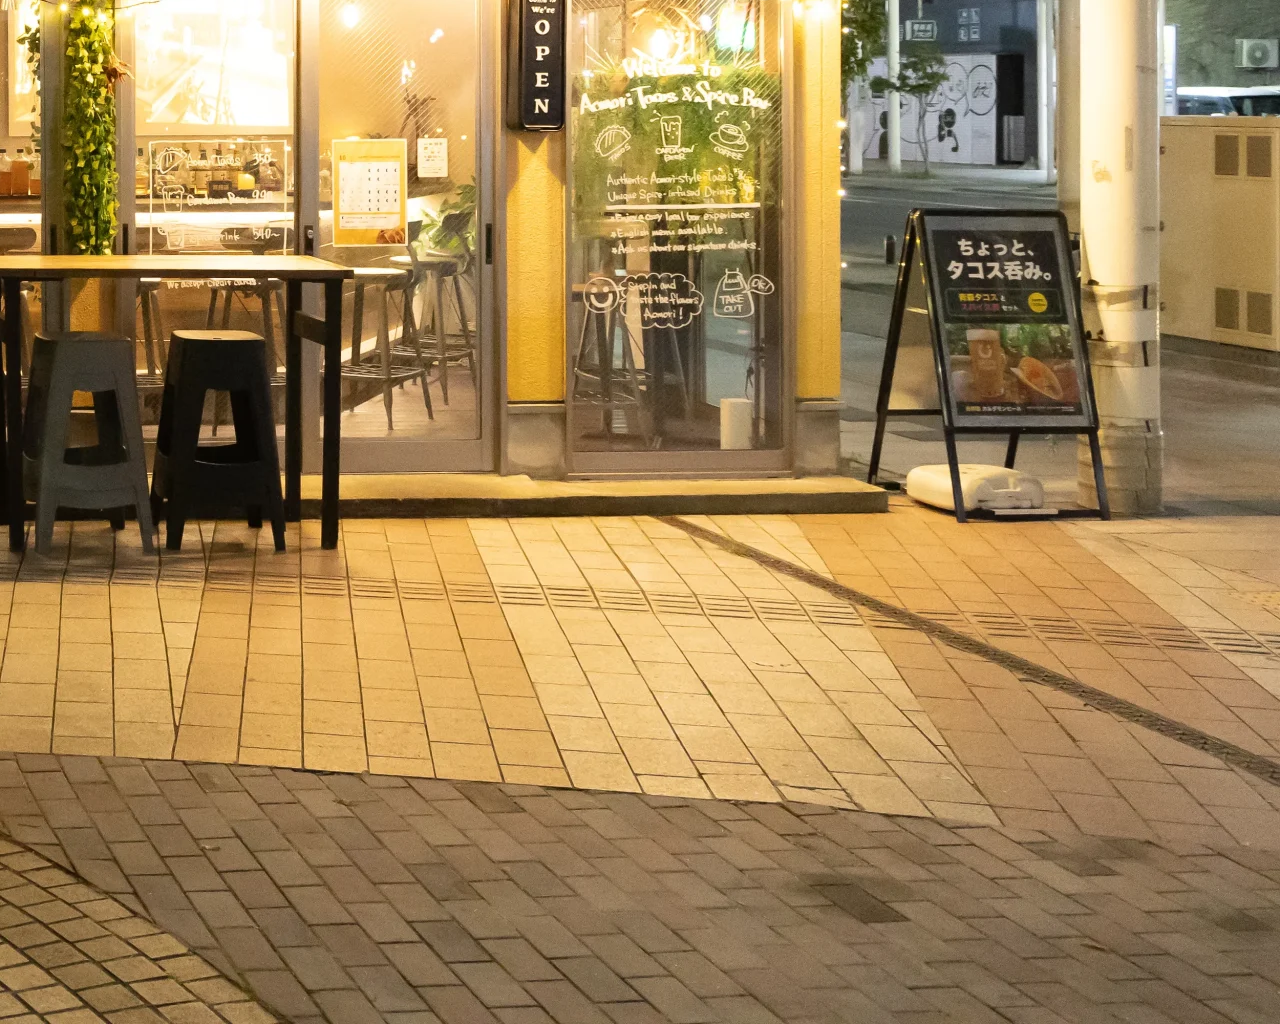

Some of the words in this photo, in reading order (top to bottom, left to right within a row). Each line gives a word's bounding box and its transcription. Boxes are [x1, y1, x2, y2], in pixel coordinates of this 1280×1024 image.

[531, 6, 556, 14] We're
[534, 19, 551, 114] OPEN
[700, 60, 721, 76] to
[580, 92, 633, 115] Aomori
[631, 86, 679, 109] Tacos
[682, 86, 695, 102] &
[694, 81, 740, 110] Spice
[741, 87, 772, 109] Bar
[714, 146, 744, 161] COFFEE
[607, 173, 648, 186] Authentic
[608, 190, 637, 202] Unique
[616, 226, 649, 238] English
[650, 242, 672, 252] about
[660, 278, 676, 290] and
[654, 293, 669, 304] the
[719, 295, 744, 305] TAKE
[723, 304, 743, 313] OUT
